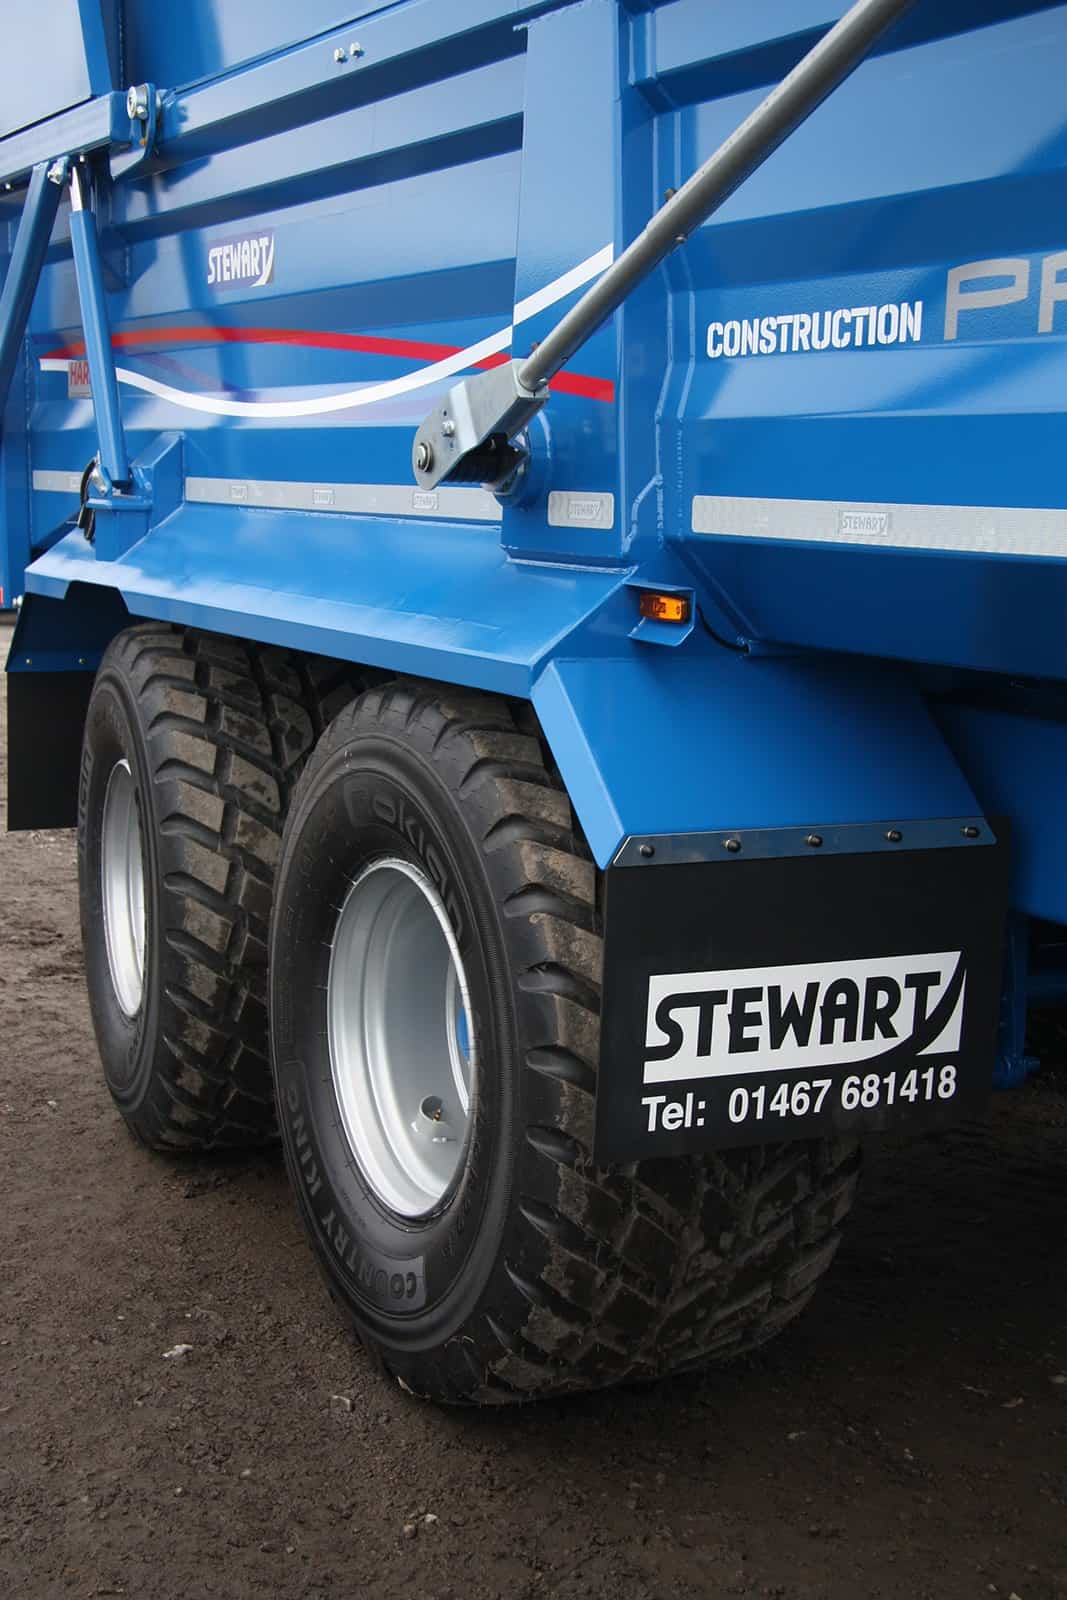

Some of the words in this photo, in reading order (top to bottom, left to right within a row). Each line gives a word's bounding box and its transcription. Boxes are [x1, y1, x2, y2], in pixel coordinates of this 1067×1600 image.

[207, 235, 274, 287] STEWART
[707, 301, 923, 358] CONSTRUCTION
[70, 361, 91, 385] HAR
[840, 513, 888, 534] STEWART
[645, 962, 965, 1062] STEWART
[641, 1093, 706, 1132] Tel:
[728, 1079, 833, 1124] 01467
[840, 1065, 958, 1111] 681418
[287, 1083, 323, 1198] KING
[321, 1208, 417, 1300] COUNTRY
